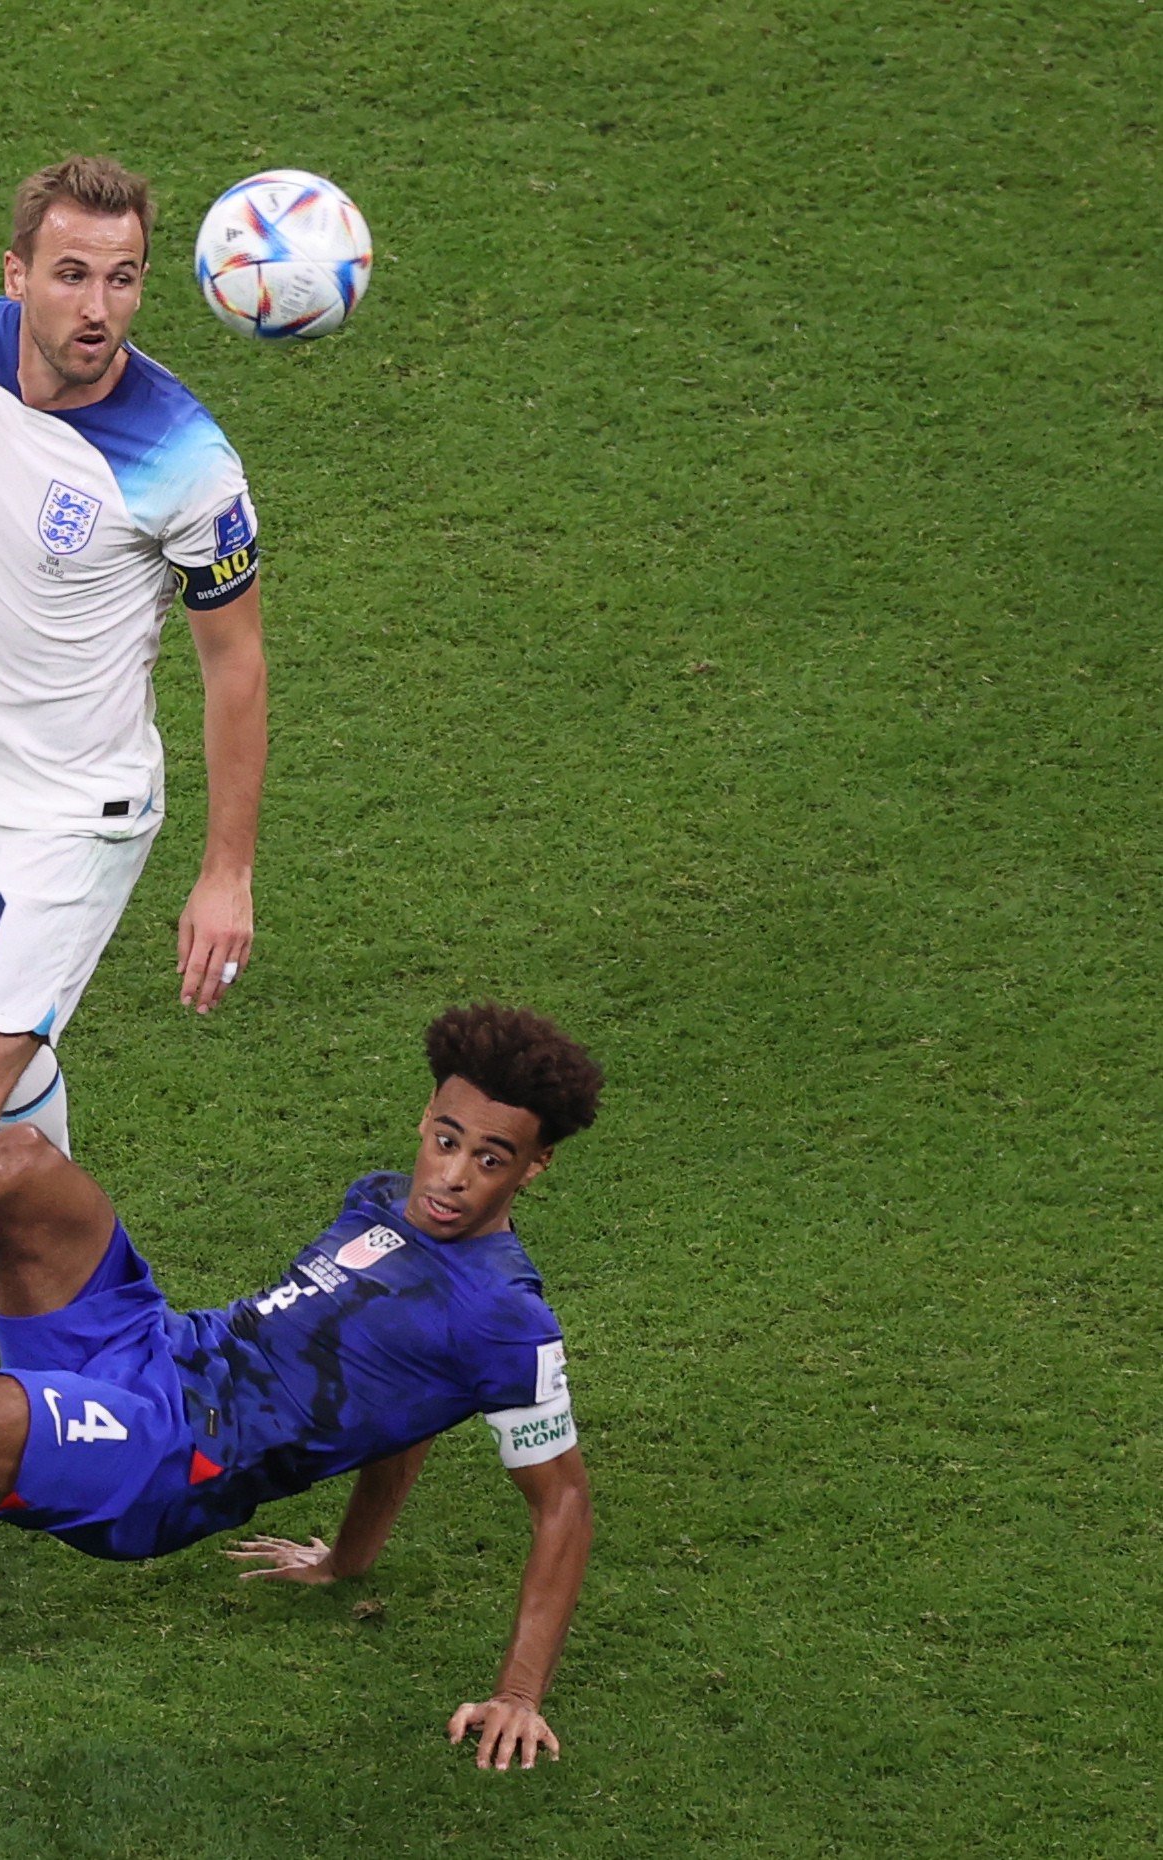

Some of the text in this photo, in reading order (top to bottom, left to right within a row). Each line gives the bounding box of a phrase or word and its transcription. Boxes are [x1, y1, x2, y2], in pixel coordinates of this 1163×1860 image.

[46, 554, 60, 567] USA
[210, 549, 250, 585] NO
[66, 1400, 129, 1443] 4
[510, 1419, 549, 1438] SAVE
